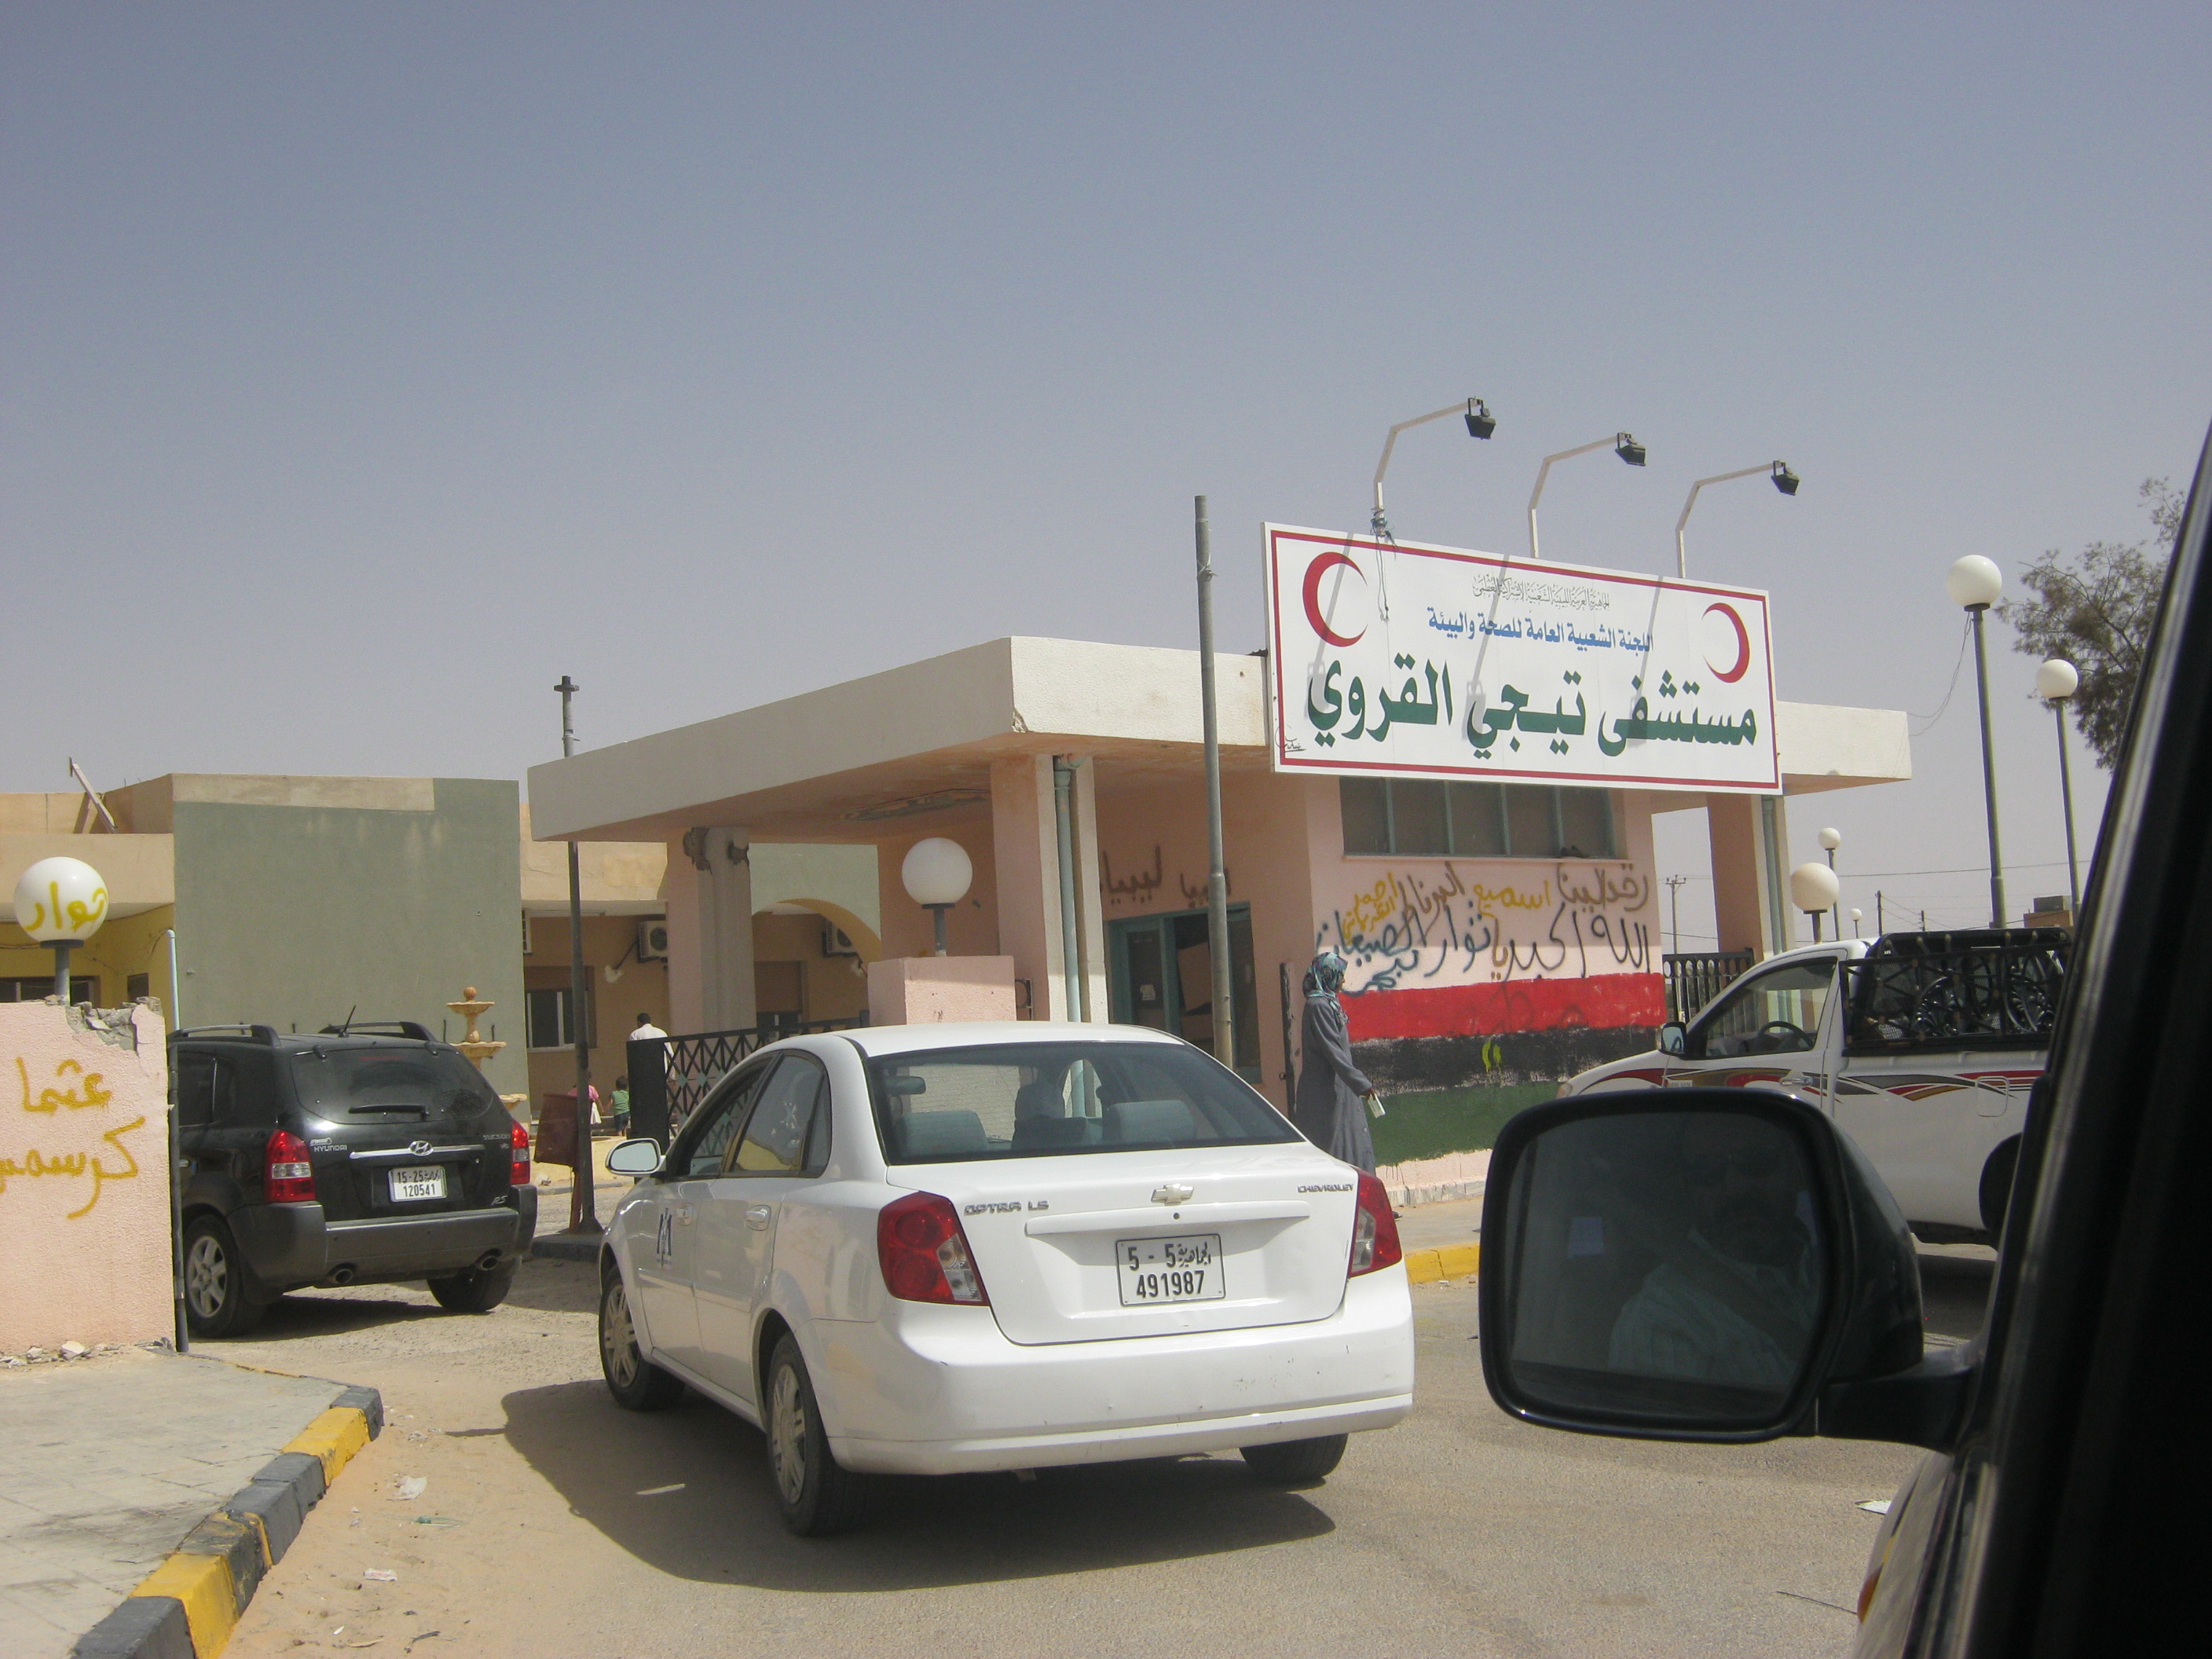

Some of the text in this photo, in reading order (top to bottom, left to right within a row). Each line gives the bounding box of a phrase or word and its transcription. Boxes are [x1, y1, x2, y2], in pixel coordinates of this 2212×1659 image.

[1426, 606, 1654, 657] اللجنة الشعبية العامة للصحة والبيئة
[1307, 652, 1757, 760] مستشفى تيجي القروي
[1591, 915, 1650, 974] الله
[314, 1144, 347, 1152] HYUNDAI
[403, 1184, 435, 1197] 120541
[1298, 1183, 1353, 1193] CHEVROLET
[964, 1199, 1049, 1215] OPTRA LS
[1137, 1270, 1204, 1298] 491987
